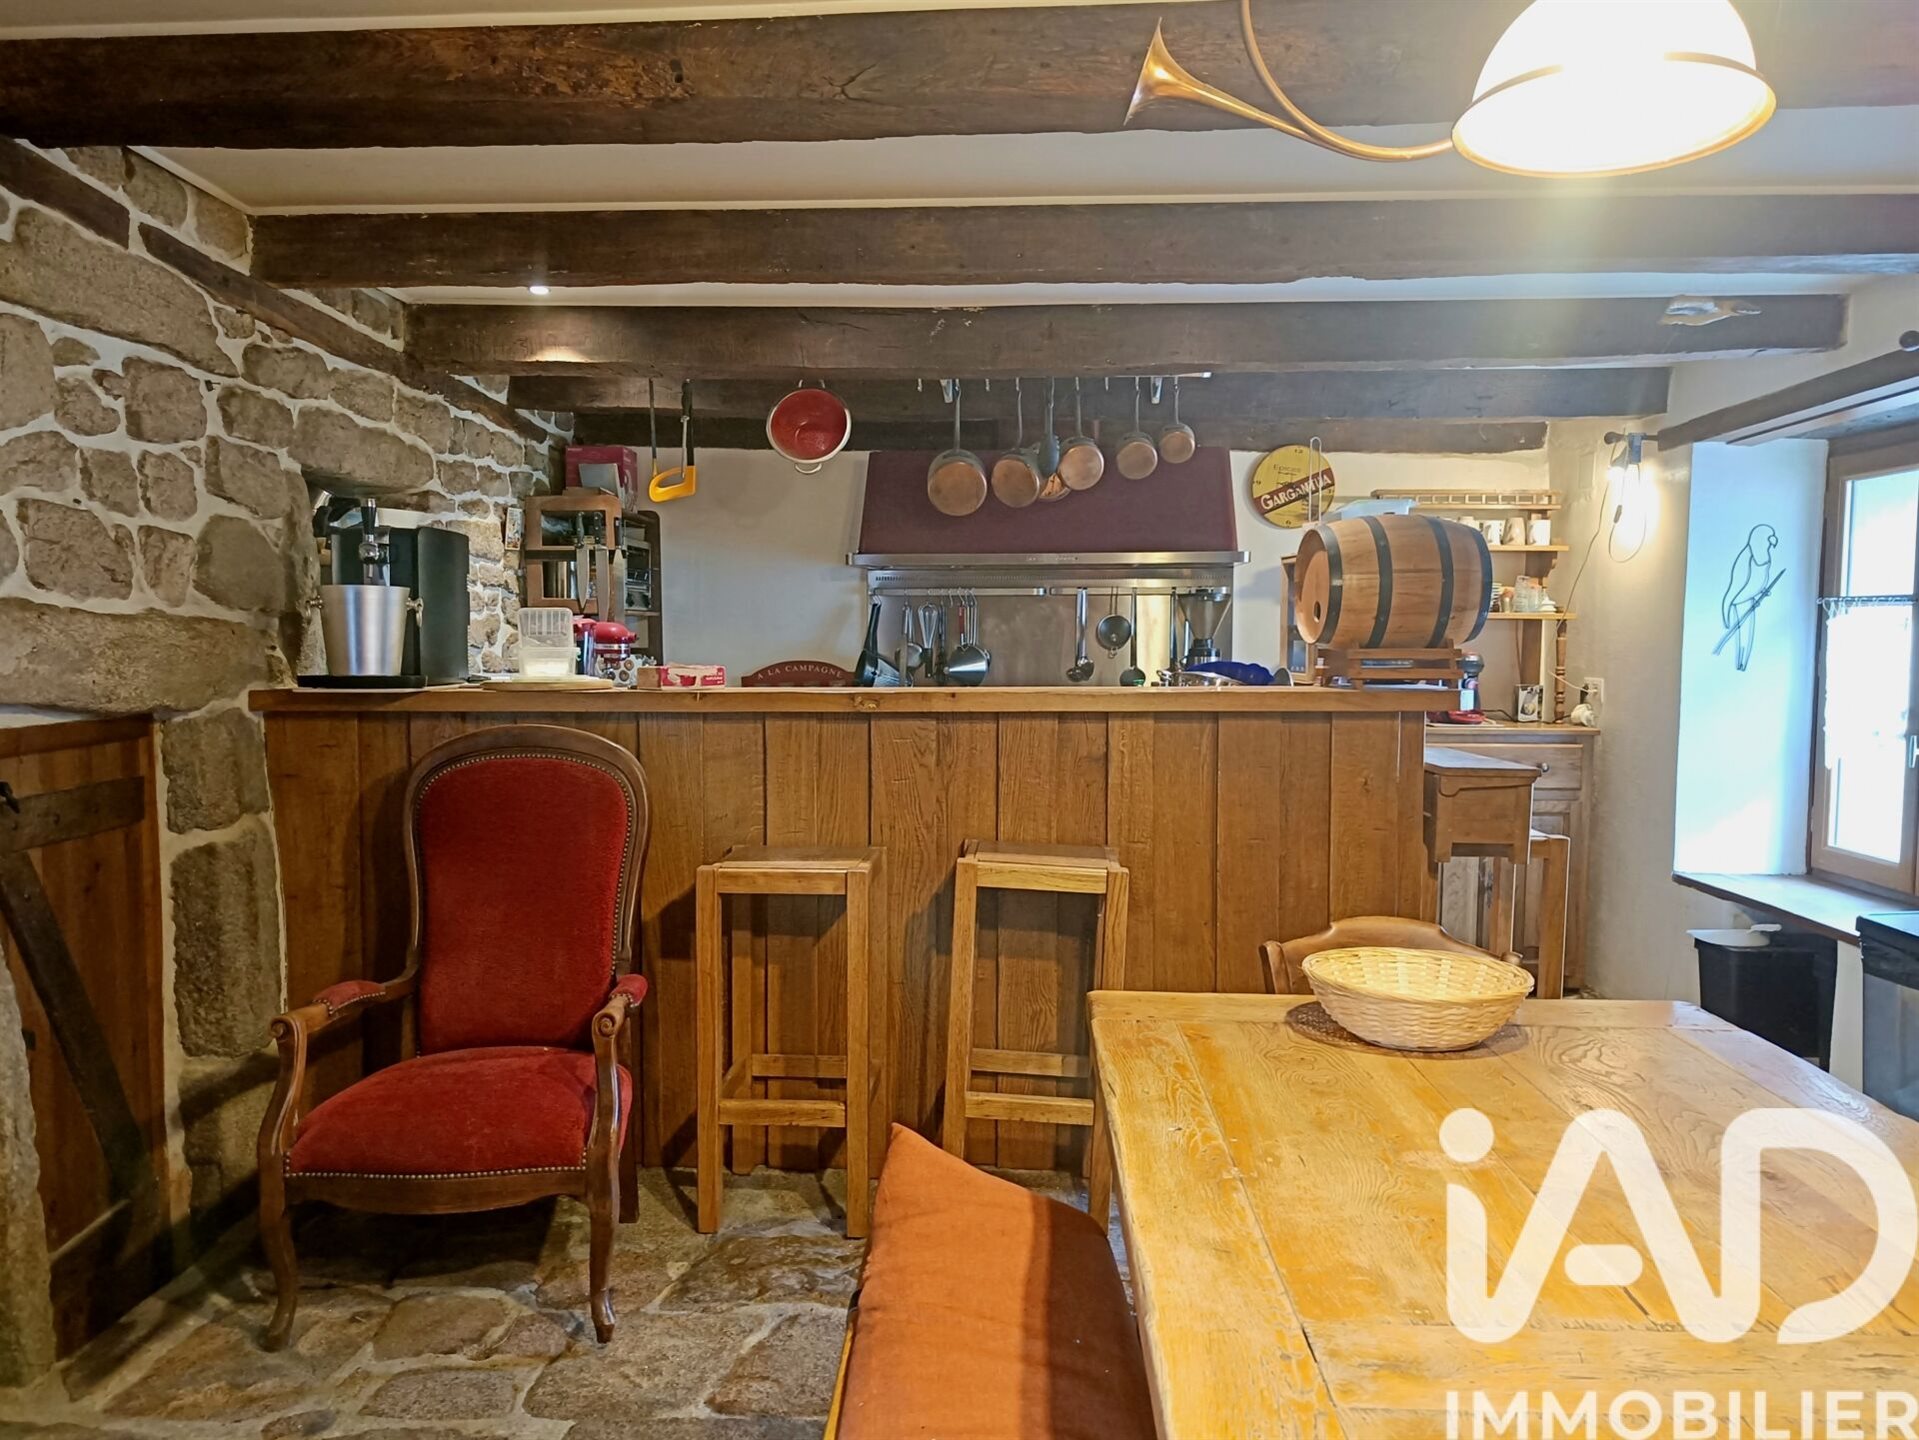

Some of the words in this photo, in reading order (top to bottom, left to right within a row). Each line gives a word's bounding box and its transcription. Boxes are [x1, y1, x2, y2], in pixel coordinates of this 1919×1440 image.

[1260, 474, 1332, 510] GARGANTUA
[767, 667, 781, 676] LA
[785, 664, 842, 679] CAMPAGNE
